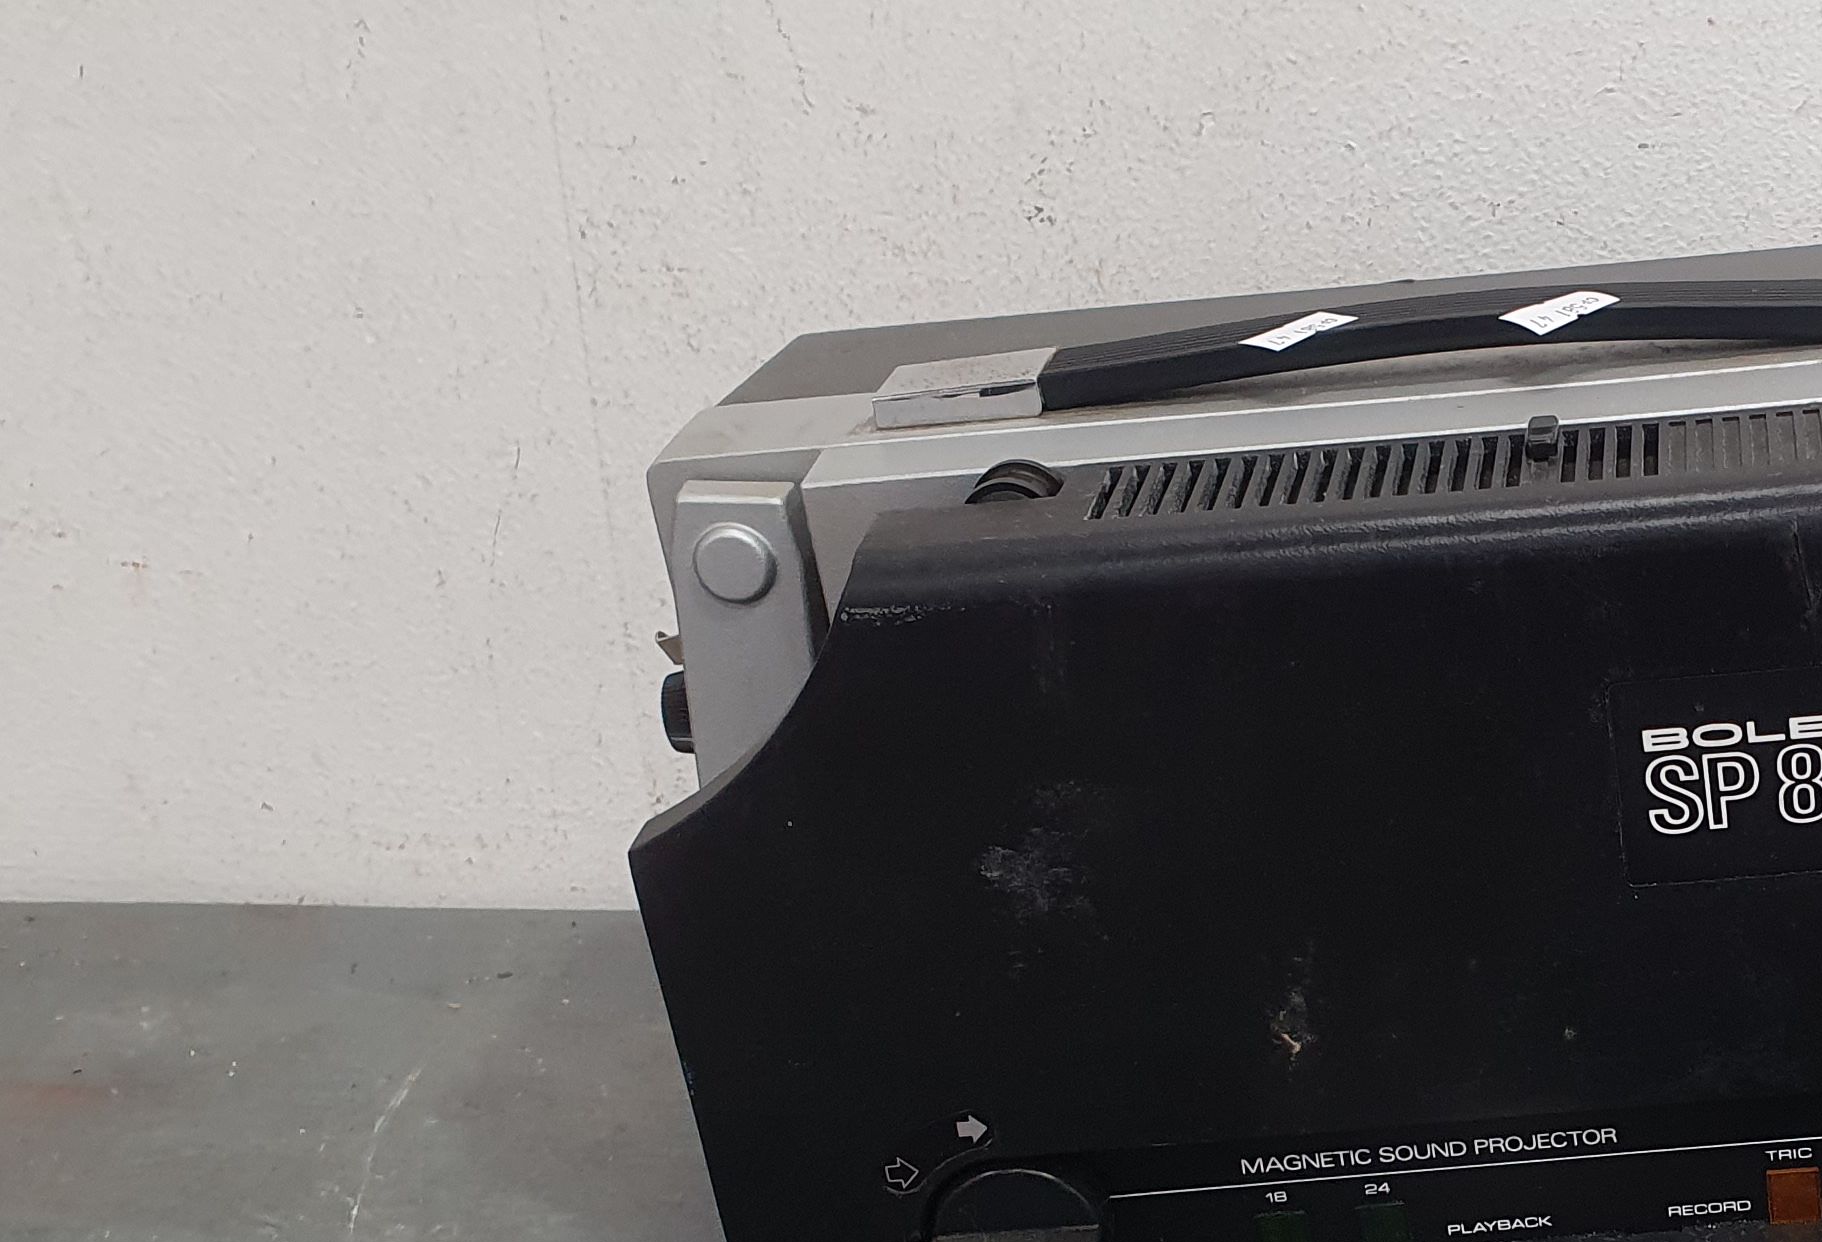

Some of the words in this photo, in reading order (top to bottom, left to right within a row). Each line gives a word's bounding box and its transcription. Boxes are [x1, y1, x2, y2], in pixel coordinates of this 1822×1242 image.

[1644, 752, 1760, 836] SP
[1240, 1148, 1373, 1175] MAGNETIC
[1378, 1140, 1468, 1164] SOUND
[1473, 1127, 1619, 1156] PROJECTOR
[1764, 1147, 1813, 1162] TRIC
[1265, 1190, 1288, 1204] 18
[1364, 1181, 1391, 1196] 24
[1667, 1199, 1752, 1218] RECORD
[1447, 1215, 1553, 1236] PLAYBACK
